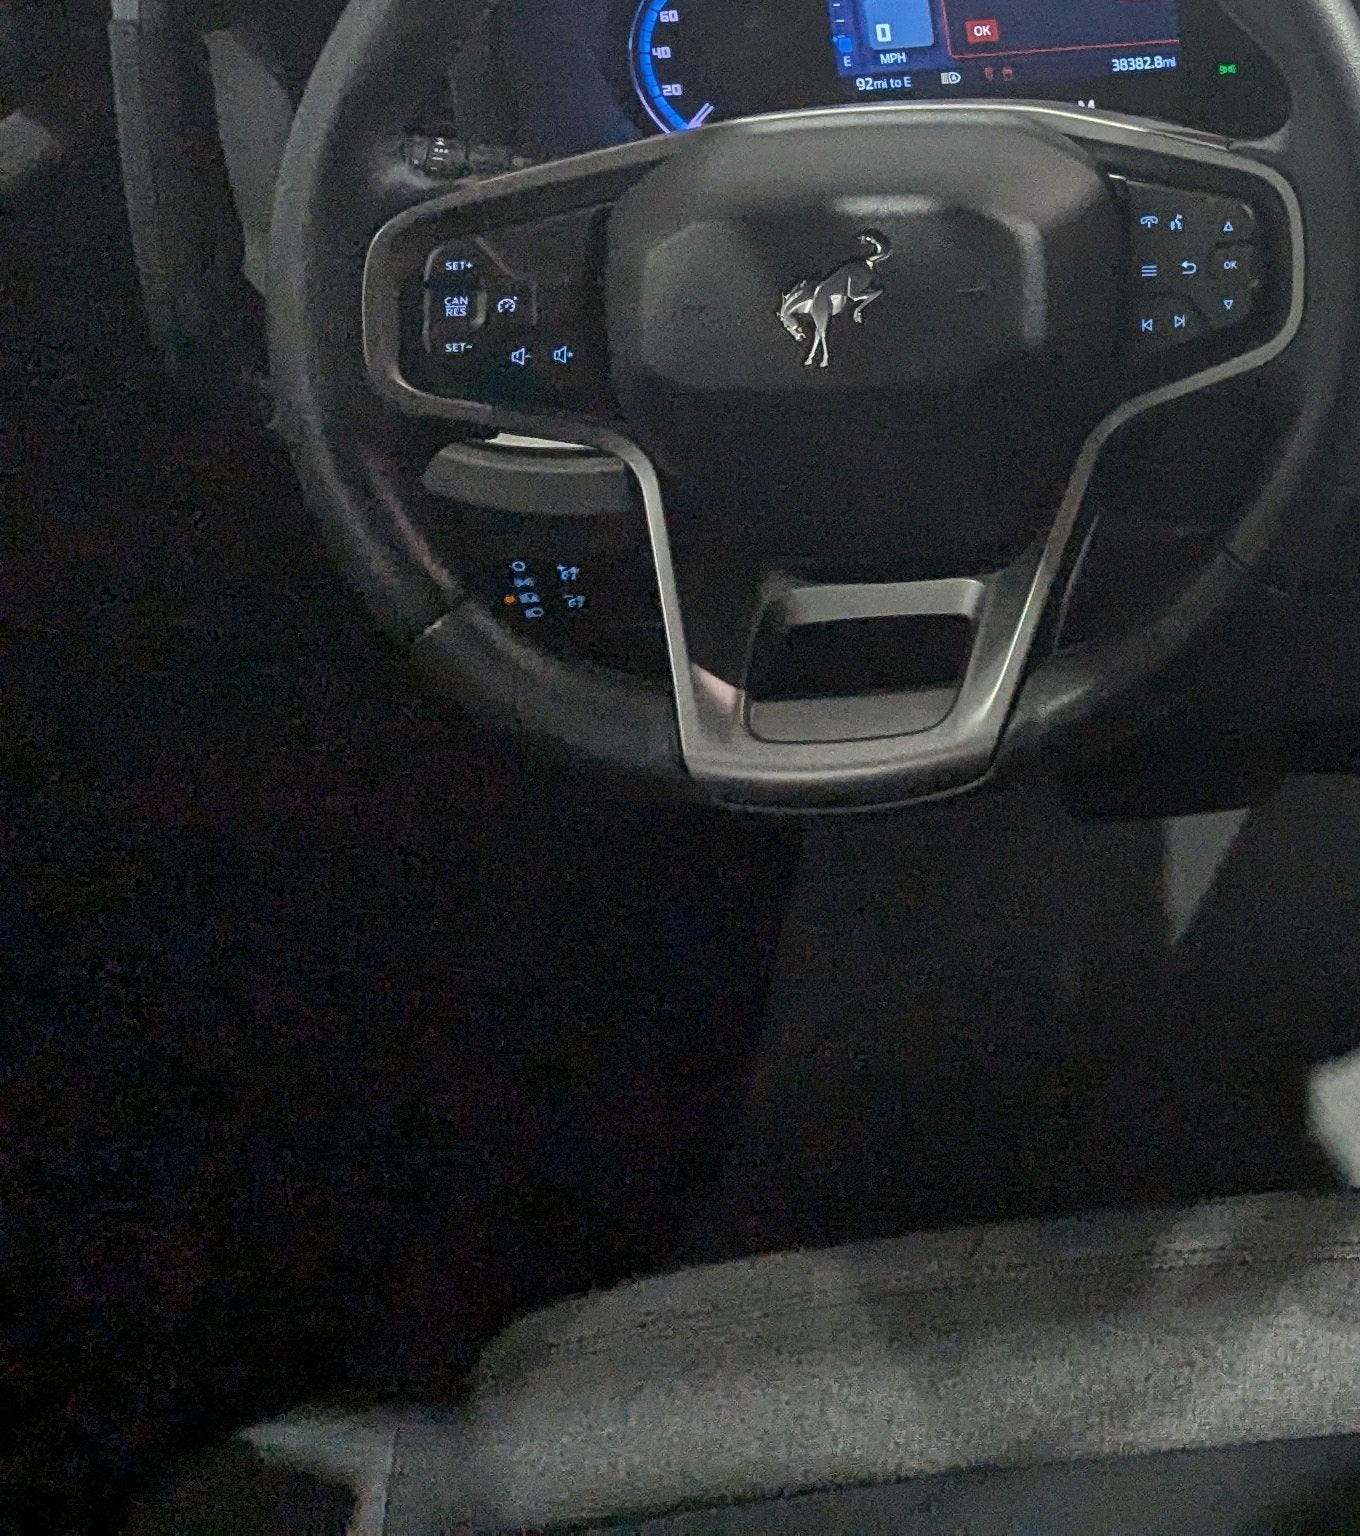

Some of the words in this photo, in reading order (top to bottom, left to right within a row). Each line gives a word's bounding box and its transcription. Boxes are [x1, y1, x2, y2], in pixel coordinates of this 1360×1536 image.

[659, 10, 679, 22] 60
[875, 23, 892, 42] 0
[973, 25, 991, 37] OK
[652, 46, 671, 59] 40
[880, 52, 907, 64] MPH
[843, 56, 852, 66] E
[856, 77, 888, 91] 92mi
[890, 77, 902, 88] to
[903, 76, 912, 87] E
[662, 84, 682, 96] 20
[1223, 260, 1237, 270] OK
[444, 296, 468, 306] CAN
[445, 308, 467, 317] RES
